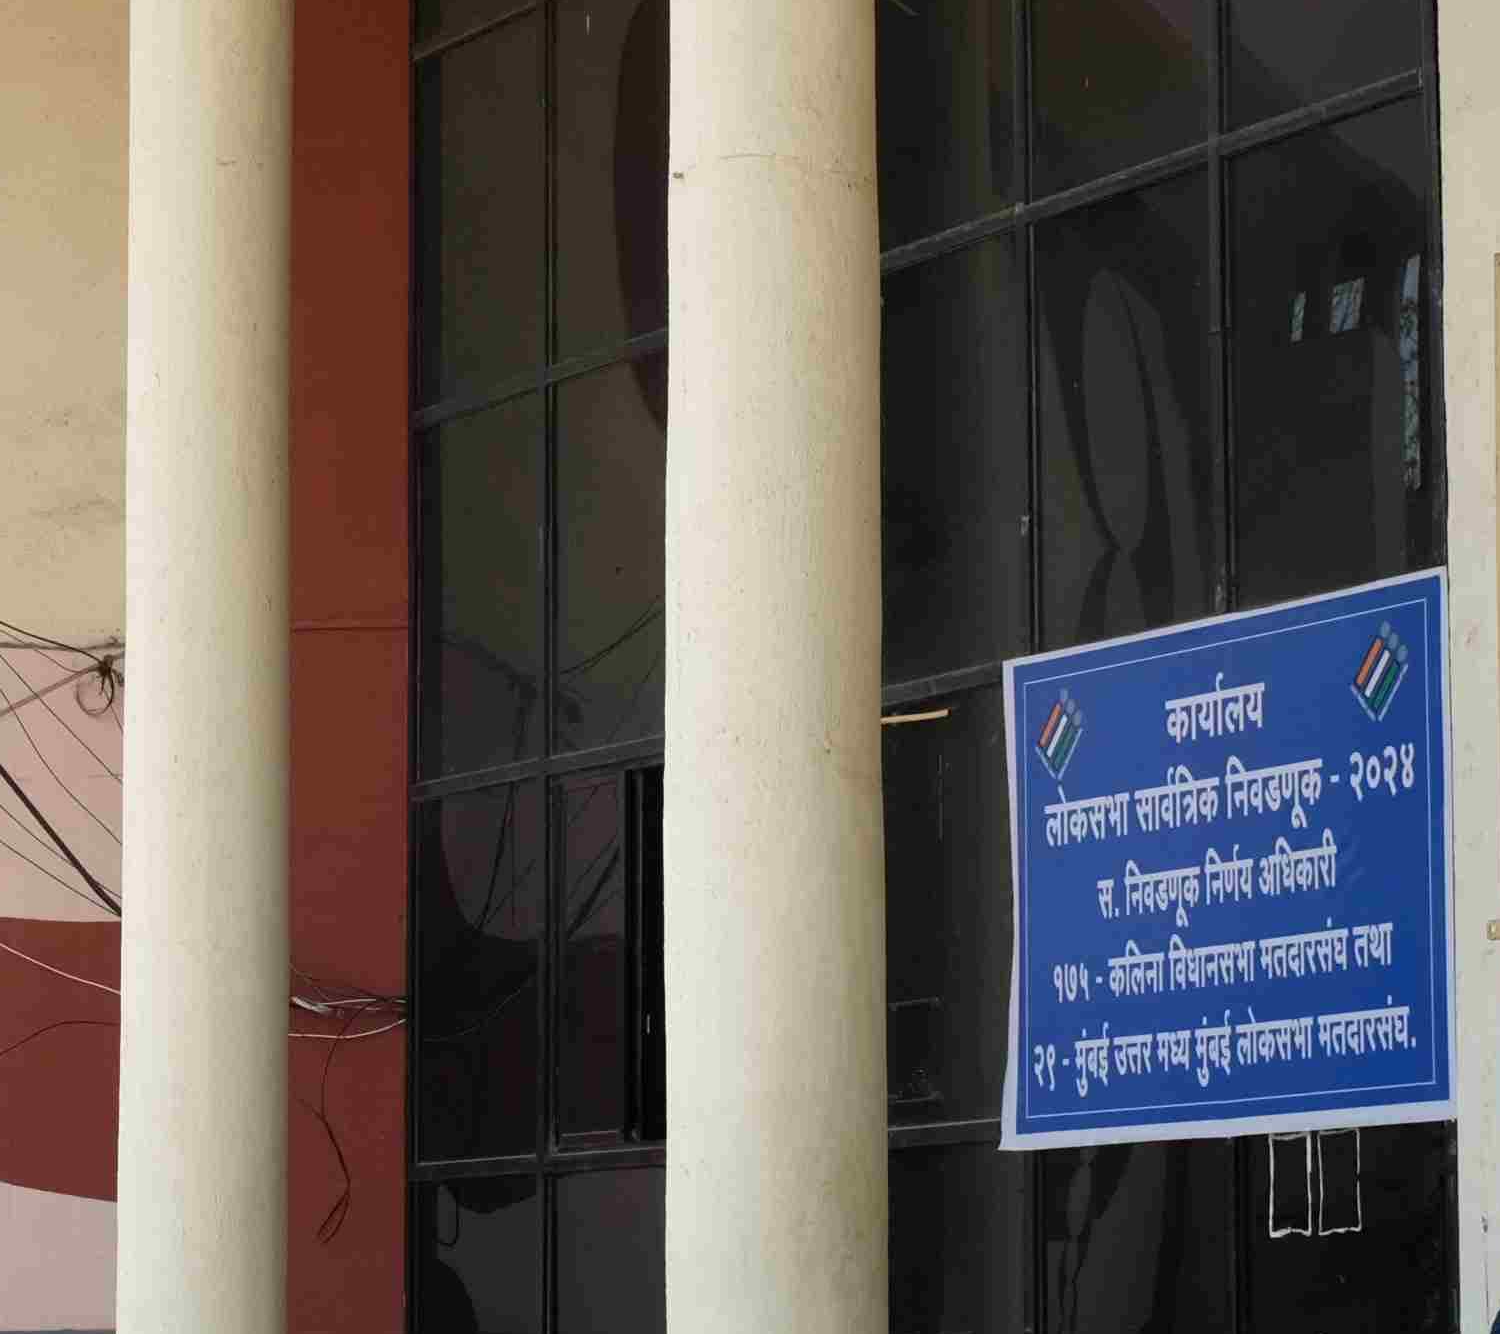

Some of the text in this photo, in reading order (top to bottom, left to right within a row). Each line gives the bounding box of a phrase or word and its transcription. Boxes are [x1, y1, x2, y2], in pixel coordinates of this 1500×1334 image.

[1164, 672, 1265, 743] कार्यालय
[1044, 785, 1130, 847] लोकसभा
[1134, 765, 1220, 833] सार्वत्रिक
[1225, 755, 1323, 828] निवडणूक
[1350, 742, 1415, 802] २०२४
[1097, 828, 1338, 927] स. निवडणूक निर्णय अधिकारी
[1053, 962, 1091, 1004] १७५
[1107, 940, 1165, 997] कलिना
[1168, 934, 1256, 991] विधानसभा
[1259, 917, 1349, 979] मतदारसंघ
[1352, 922, 1393, 968] तथा
[1034, 1043, 1056, 1092] २९
[1074, 1022, 1109, 1097] मुंबई
[1113, 1034, 1152, 1075] उत्तर
[1156, 1030, 1191, 1071] मध्य
[1195, 1009, 1232, 1087] मुंबई
[1236, 1005, 1314, 1065] लोकसभा
[1318, 994, 1417, 1058] मतदारसंघ.
